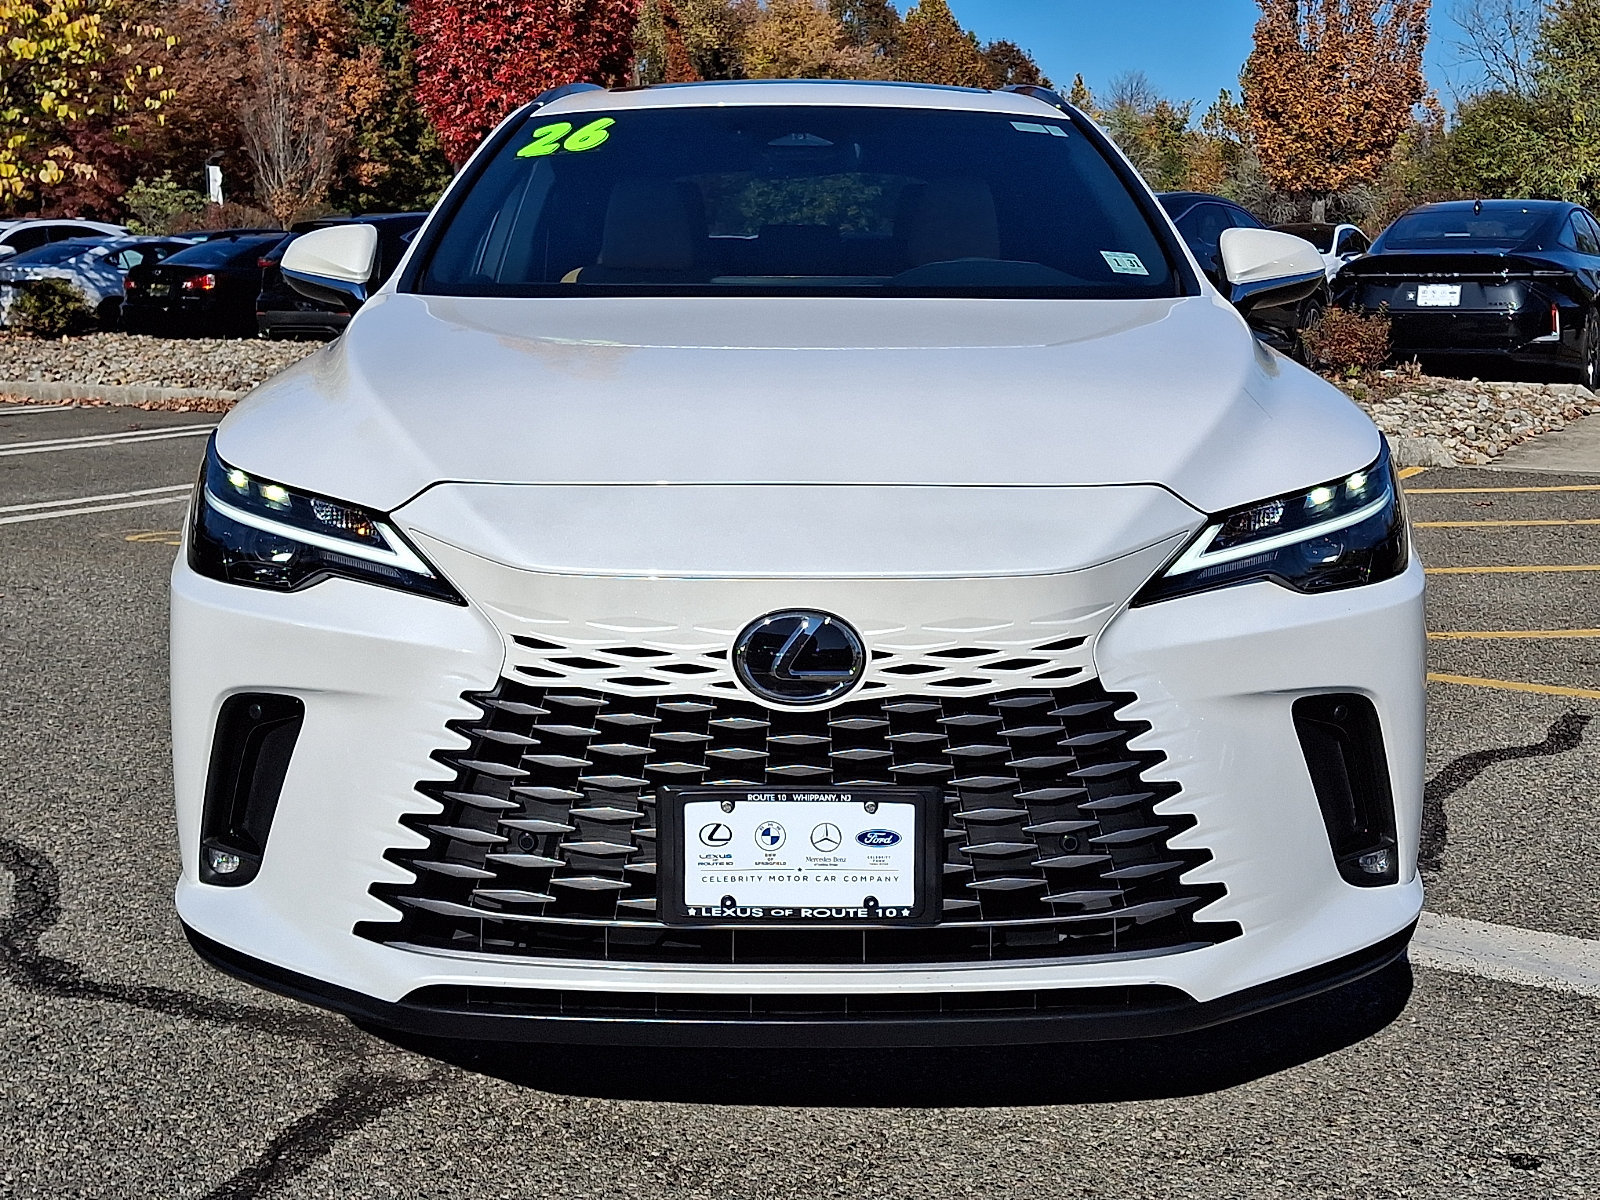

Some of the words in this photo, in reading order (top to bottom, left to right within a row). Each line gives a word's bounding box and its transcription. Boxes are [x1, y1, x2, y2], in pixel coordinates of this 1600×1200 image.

[516, 117, 616, 157] 26
[1113, 258, 1122, 267] 1
[1127, 259, 1141, 268] 31
[840, 794, 851, 802] NJ
[864, 832, 894, 844] Ford
[701, 875, 763, 883] CELEBRITY
[843, 875, 899, 883] COMPANY
[701, 907, 764, 918] LEXUS
[770, 908, 793, 917] OF
[800, 908, 868, 918] ROUTE
[875, 908, 898, 918] 10
